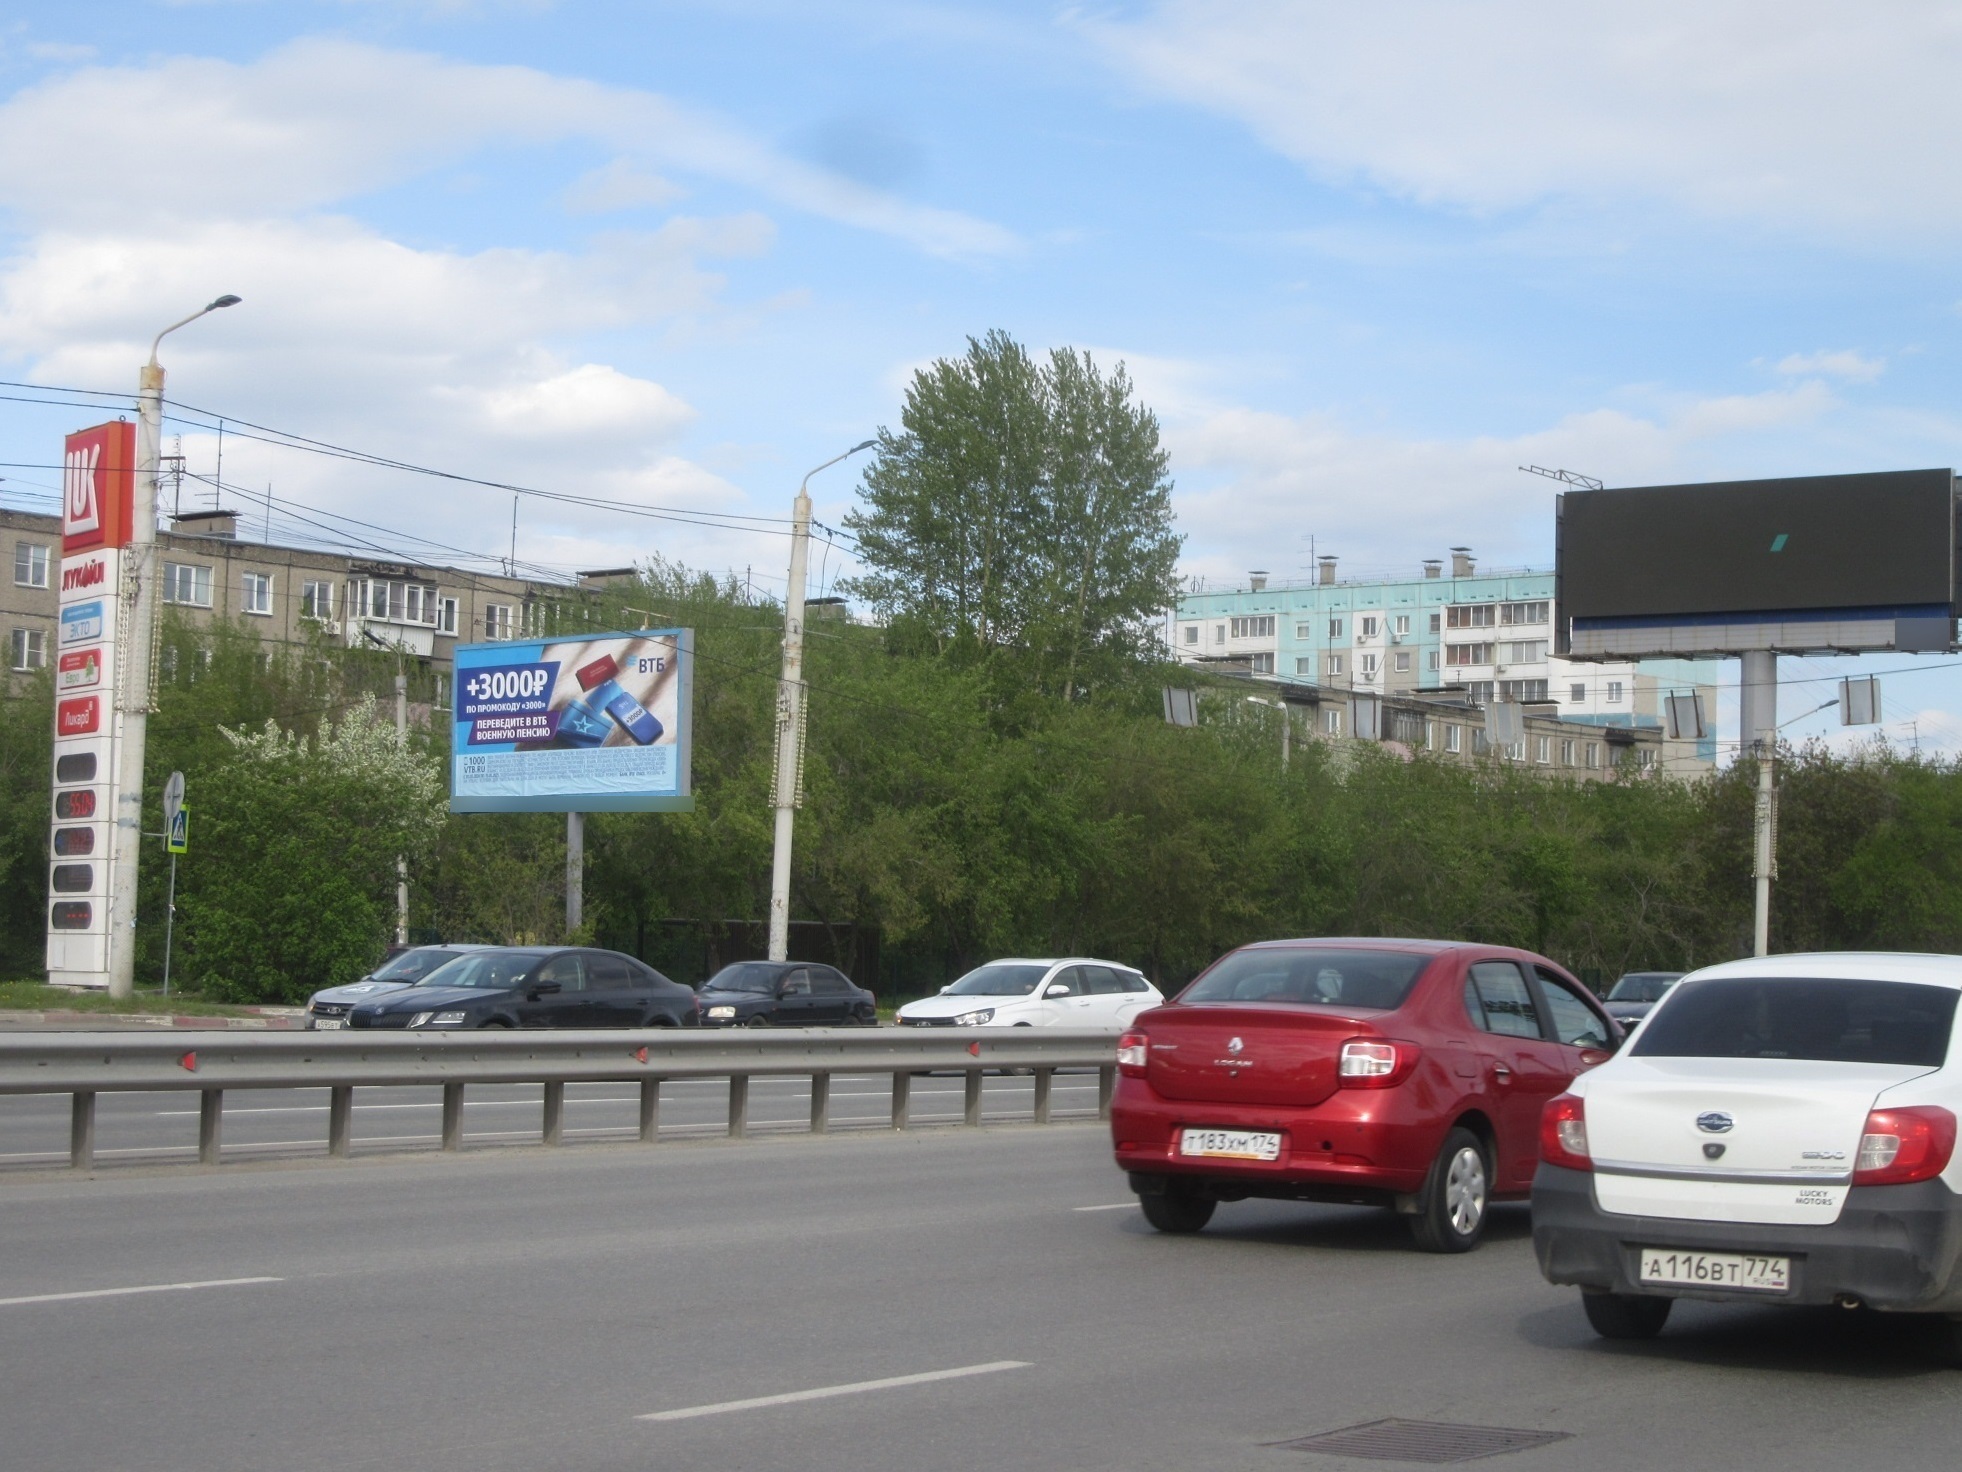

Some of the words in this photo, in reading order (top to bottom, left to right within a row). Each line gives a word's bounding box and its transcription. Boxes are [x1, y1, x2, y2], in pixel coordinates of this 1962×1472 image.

[639, 658, 665, 674] ВТБ
[467, 670, 548, 699] +3000₽
[466, 705, 477, 714] ПО
[477, 701, 522, 713] ПРОМОКОДУ
[477, 717, 525, 730] ПЕРЕВЕДИТЕ
[526, 717, 532, 727] В
[532, 716, 548, 726] ВТБ
[476, 729, 515, 741] ВОЕННУЮ
[516, 728, 551, 739] ПЕНСИЮ
[469, 756, 486, 766] 1000
[463, 765, 486, 774] VTB.RU
[1250, 1134, 1277, 1148] 174
[1799, 1189, 1829, 1198] LUCKY
[1795, 1197, 1833, 1206] MOTORS
[1649, 1254, 1740, 1282] А116ВТ
[1746, 1257, 1784, 1278] 774
